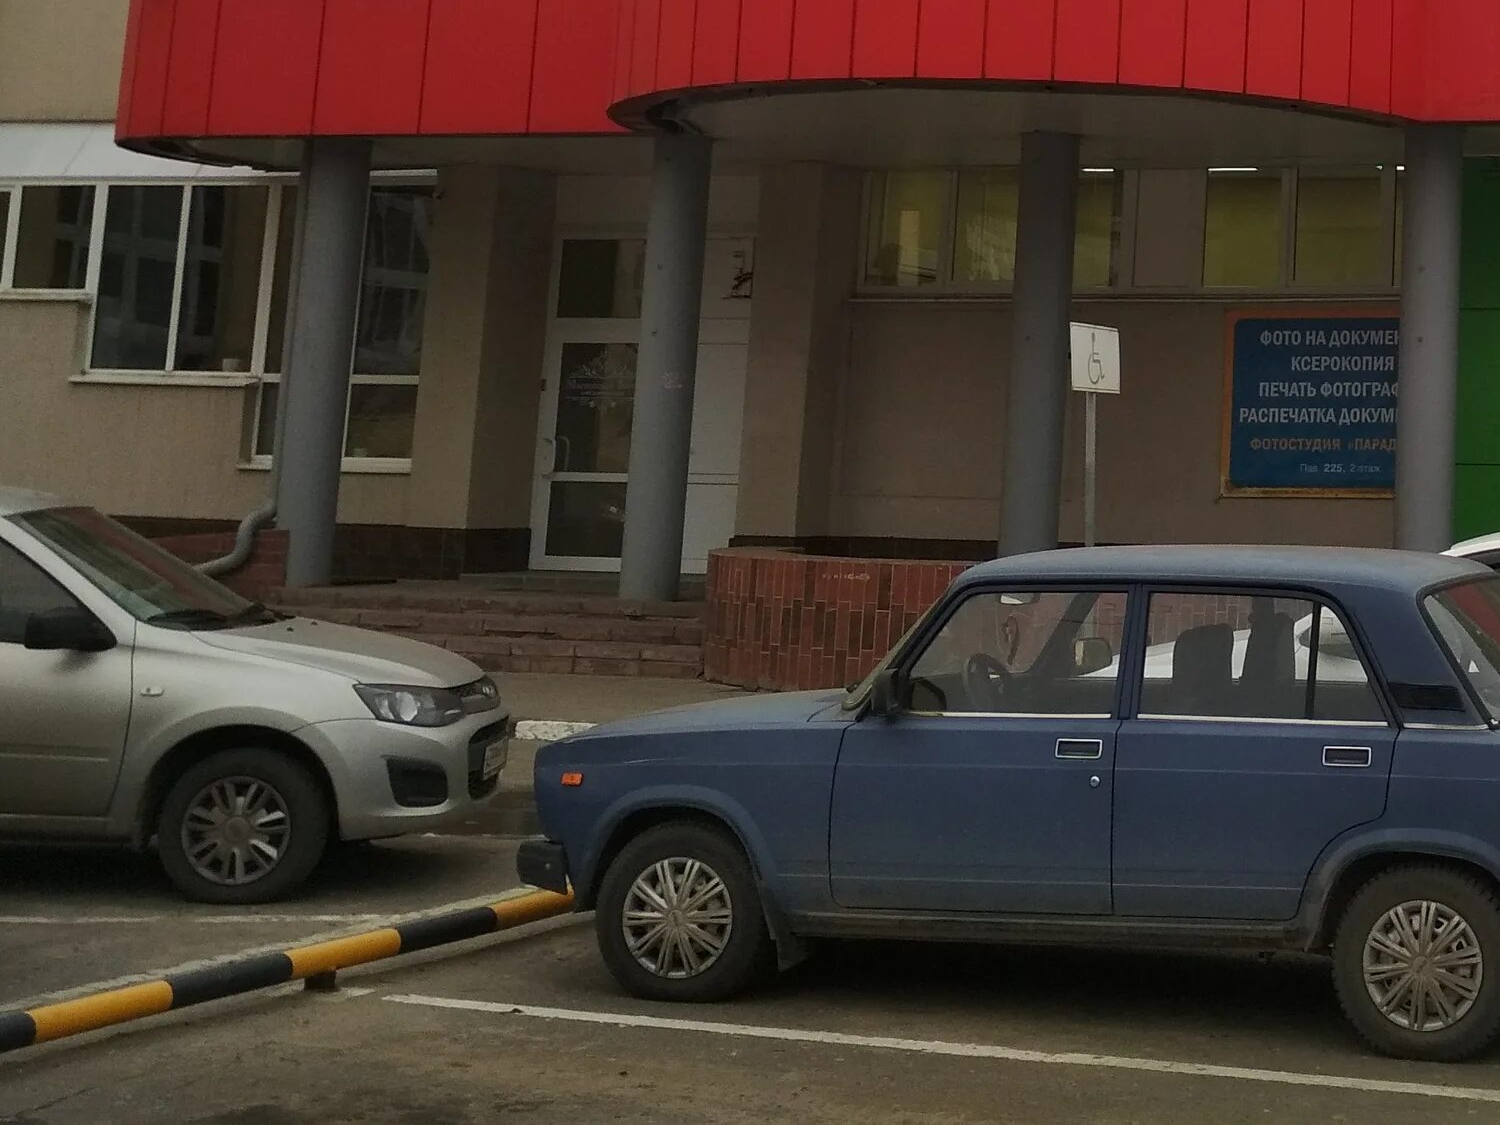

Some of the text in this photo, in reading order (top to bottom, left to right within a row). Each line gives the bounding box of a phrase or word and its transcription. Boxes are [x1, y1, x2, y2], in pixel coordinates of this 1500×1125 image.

[1260, 330, 1301, 345] ФОТО
[1306, 331, 1326, 345] НА
[1291, 356, 1394, 371] КСЕРОКОПИЯ
[1259, 382, 1316, 397] ПЕЧАТЬ
[1239, 407, 1398, 425] РАСПЕЧАТКА ДОКУМ
[1250, 438, 1340, 452] ФОТОСТУДИЯ
